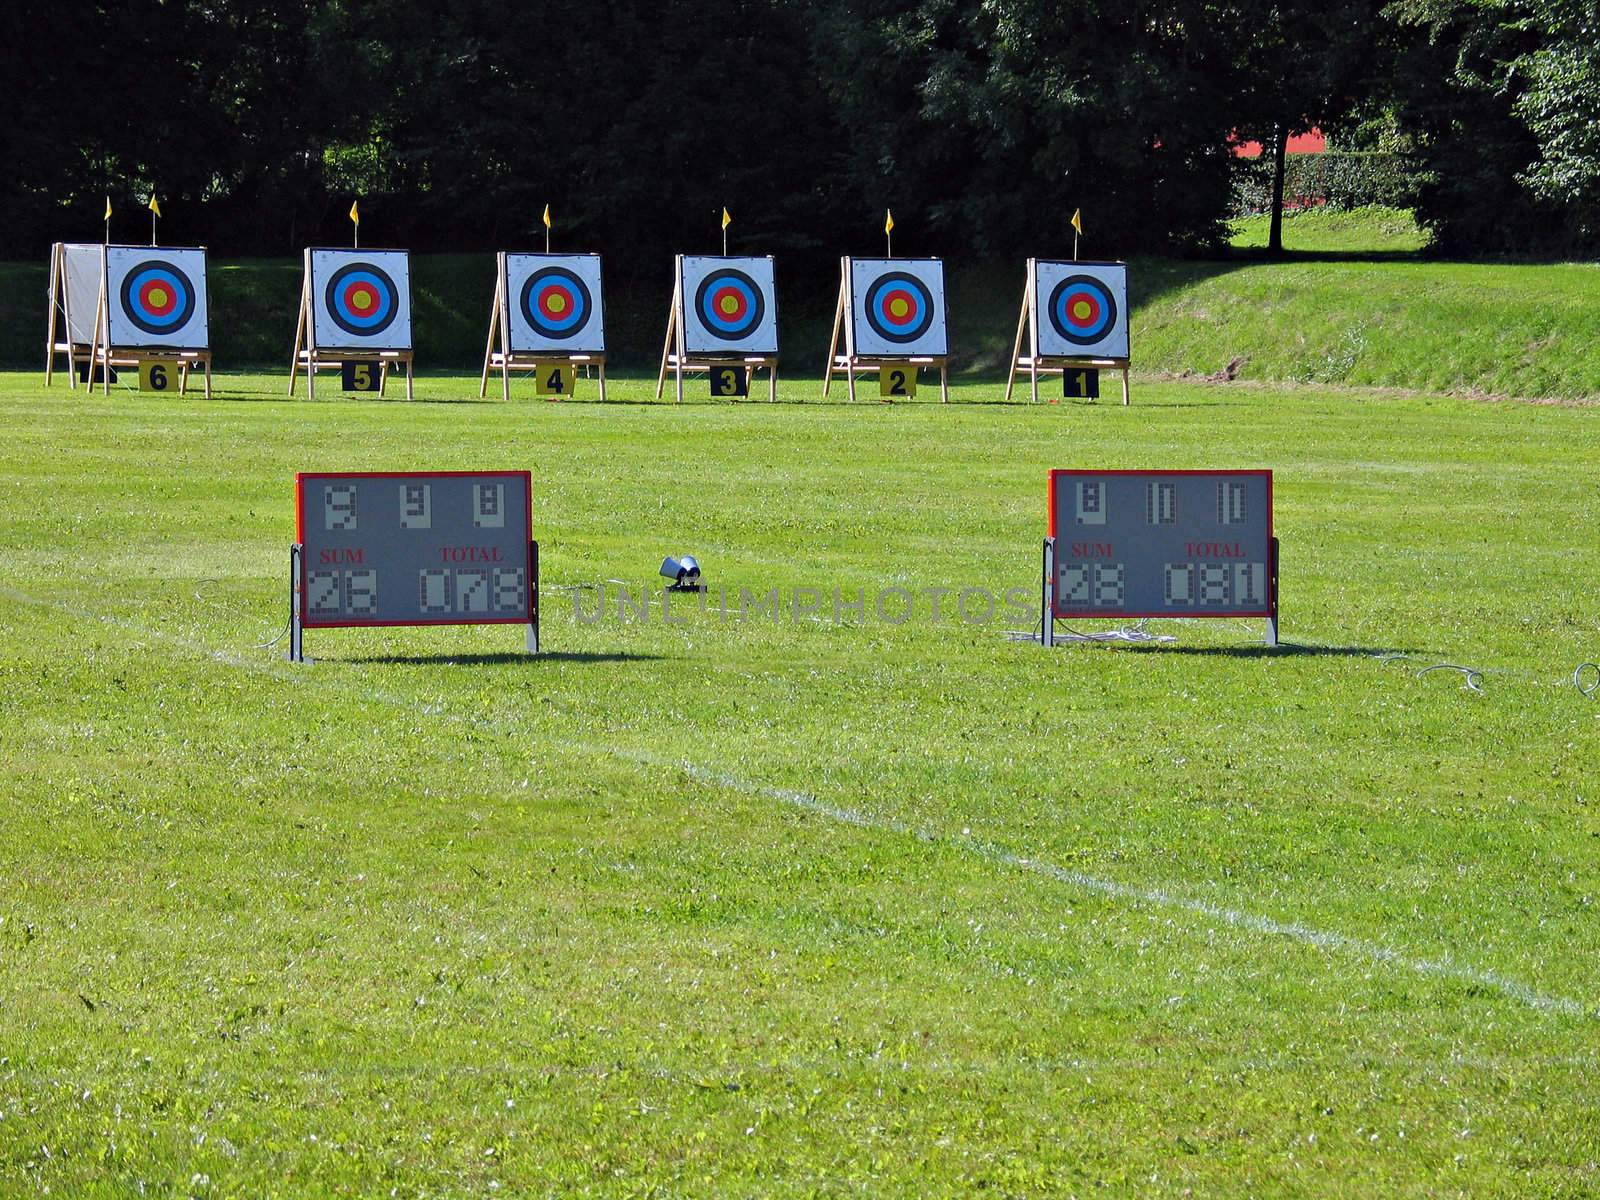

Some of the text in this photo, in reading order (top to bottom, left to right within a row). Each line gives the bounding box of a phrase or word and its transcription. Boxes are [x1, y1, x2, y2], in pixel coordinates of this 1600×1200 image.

[149, 364, 167, 391] 6
[353, 364, 371, 391] 5
[546, 368, 564, 394] 4
[720, 369, 736, 395] 3
[889, 370, 906, 395] 2
[1075, 371, 1087, 396] 1
[326, 485, 356, 529] 9
[1147, 482, 1176, 525] 10
[1217, 482, 1247, 525] 10
[319, 546, 504, 564] SUM TOTAL
[1071, 542, 1247, 559] SUM TOTAL
[308, 567, 524, 614] 26 078
[1060, 563, 1260, 606] 28 081
